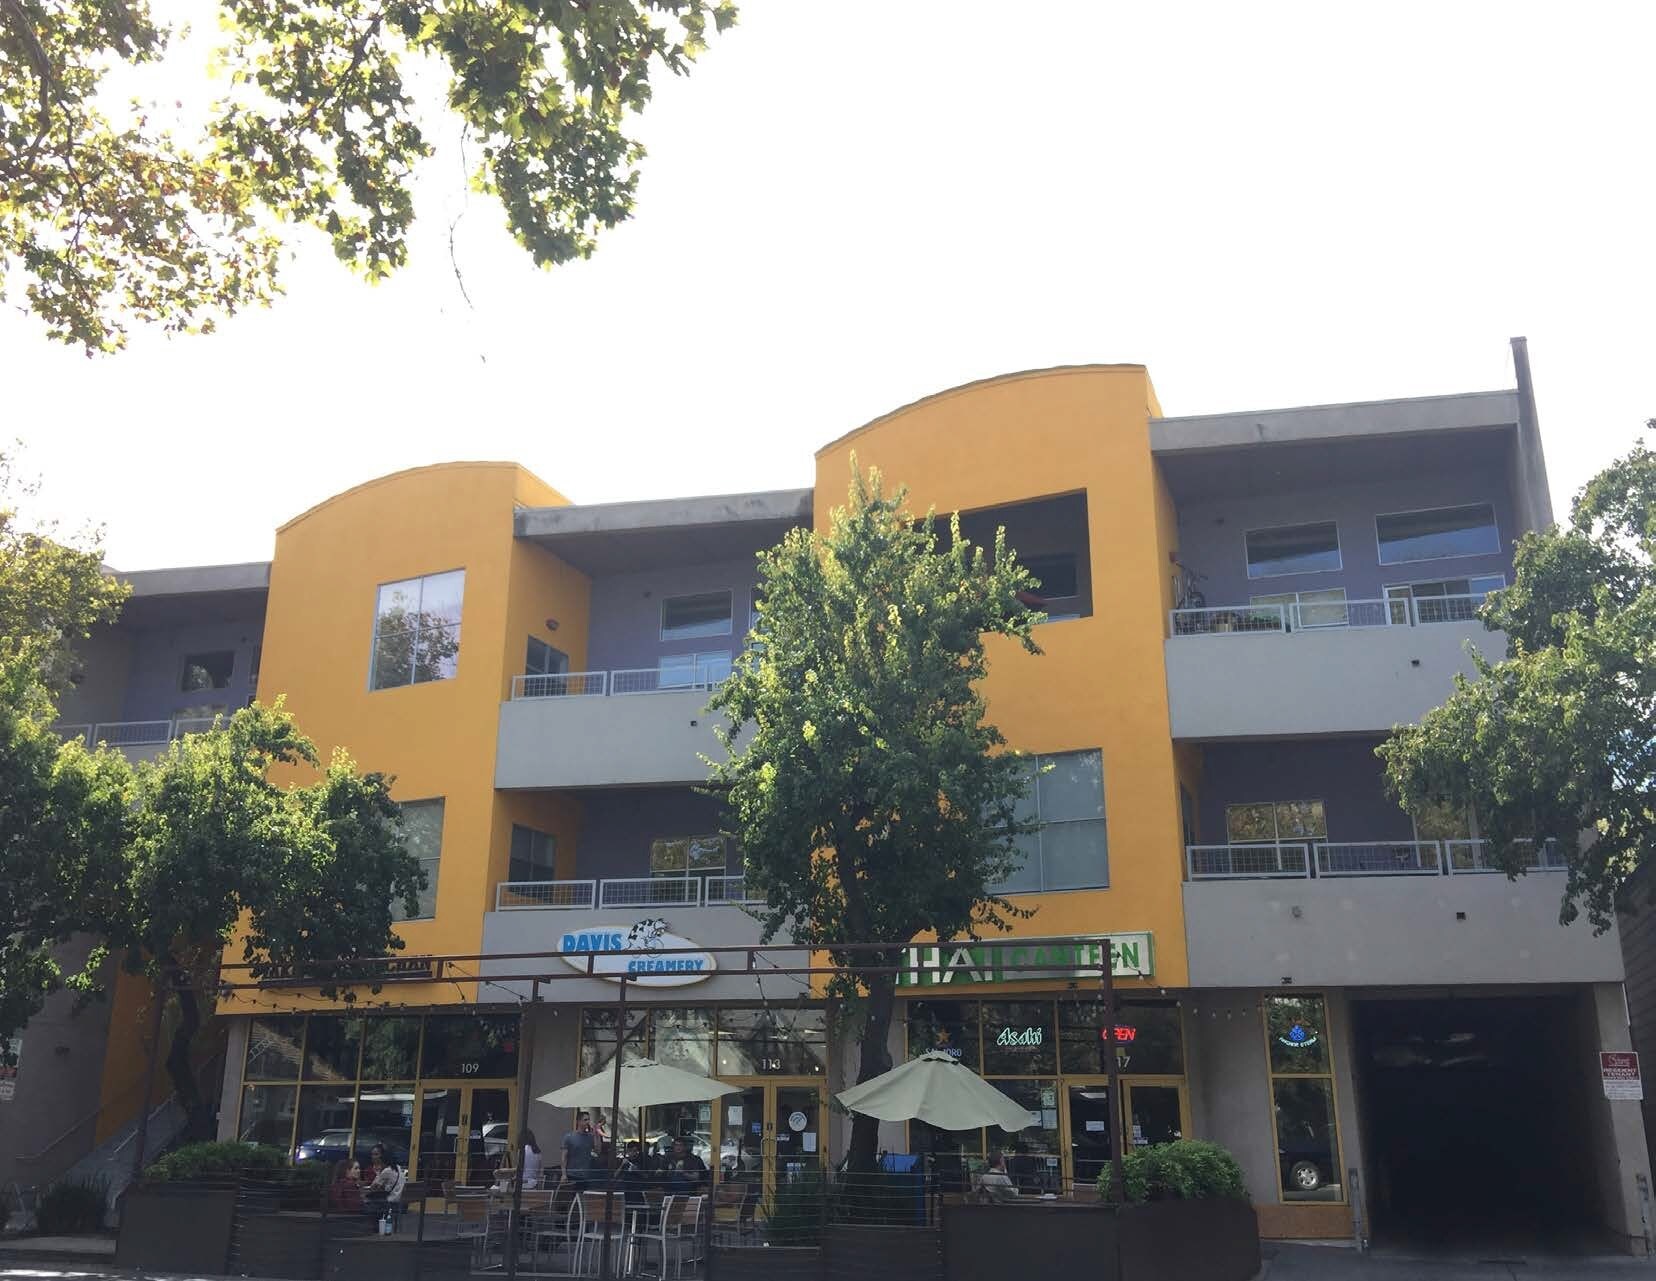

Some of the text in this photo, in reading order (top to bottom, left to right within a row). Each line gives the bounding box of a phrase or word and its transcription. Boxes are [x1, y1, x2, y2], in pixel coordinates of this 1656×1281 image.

[563, 933, 623, 952] DAVIS
[628, 959, 704, 973] CREAMERY
[895, 944, 994, 985] HAI
[997, 1027, 1042, 1046] Asahi
[461, 1063, 480, 1073] 109
[762, 1058, 781, 1070] 113
[1116, 1056, 1131, 1068] 17
